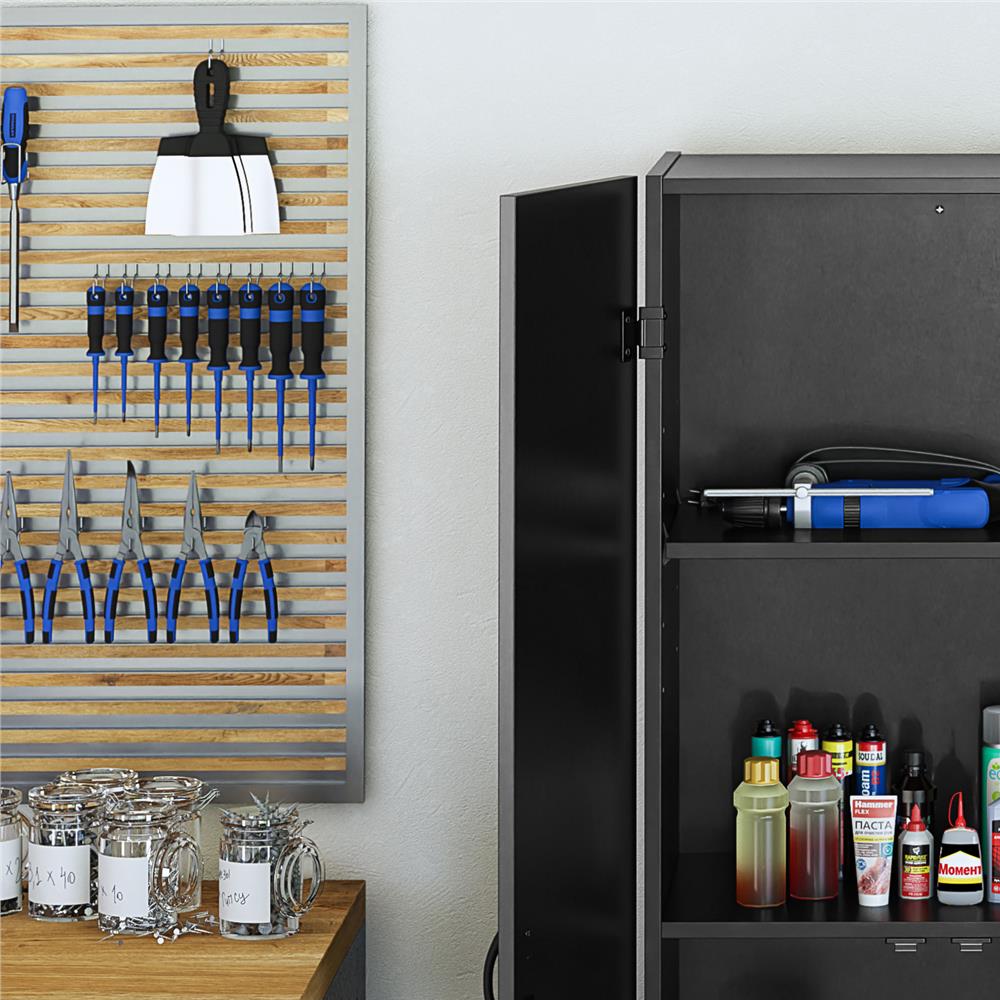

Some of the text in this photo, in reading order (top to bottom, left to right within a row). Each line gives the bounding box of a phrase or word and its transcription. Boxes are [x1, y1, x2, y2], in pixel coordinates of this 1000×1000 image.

[861, 769, 870, 796] oam
[854, 800, 894, 809] Hammer
[855, 820, 893, 831] ПАСТА
[939, 863, 982, 876] Момент
